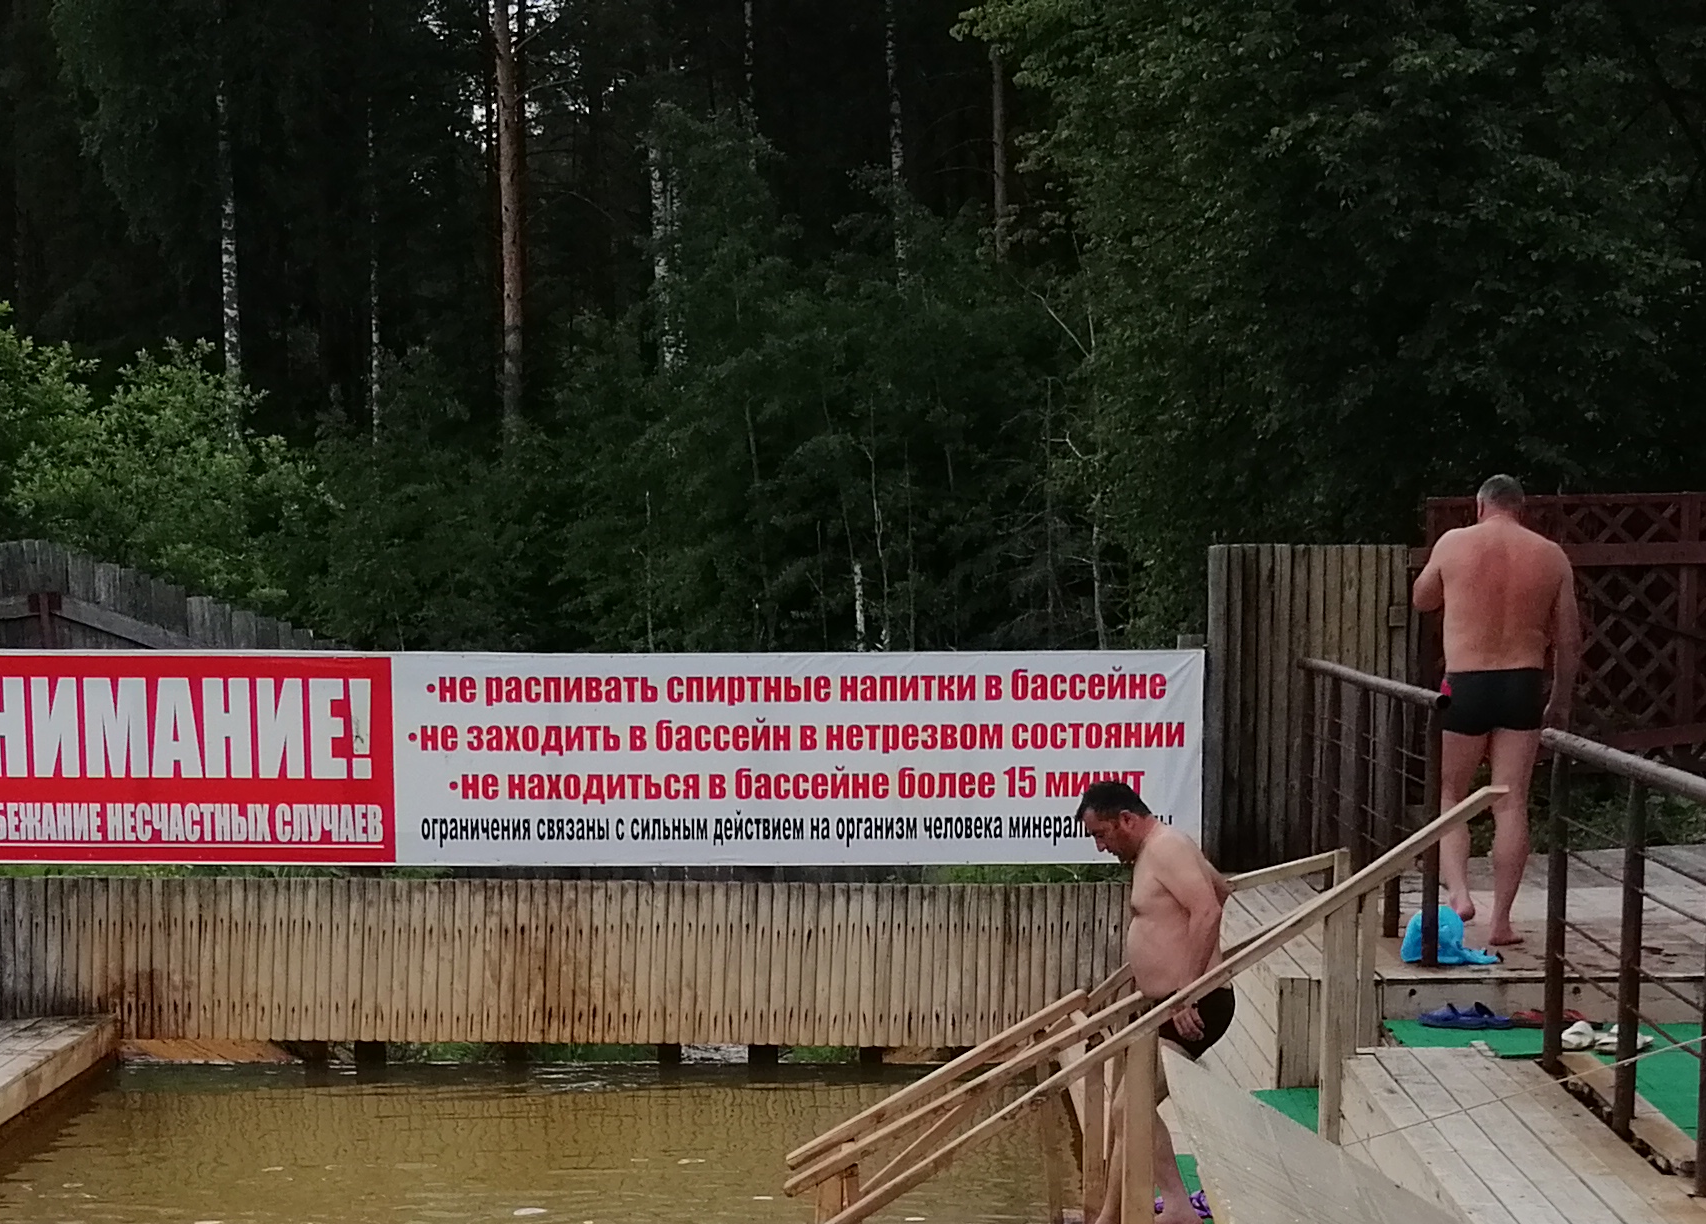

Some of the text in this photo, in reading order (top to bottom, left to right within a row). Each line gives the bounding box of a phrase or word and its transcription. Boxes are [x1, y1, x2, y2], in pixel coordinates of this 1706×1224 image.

[485, 676, 658, 707] распивать
[666, 675, 831, 706] спиртные
[840, 674, 976, 702] напитки
[985, 674, 1003, 701] в
[1011, 666, 1167, 702] бассейне
[466, 725, 621, 756] заходить
[629, 725, 647, 752] в
[655, 717, 791, 752] бассейн
[799, 724, 817, 751] в
[826, 723, 1003, 755] нетрезвом
[1011, 721, 1185, 750] состоянии
[508, 773, 701, 805] находиться
[708, 773, 726, 800] в
[734, 766, 890, 801] бассейне
[898, 767, 995, 799] более
[1003, 766, 1037, 798] 15
[106, 802, 272, 843] НЕСЧАСТНЫХ
[275, 803, 383, 843] СЛУЧАЕВ
[421, 817, 531, 848] ограничения
[536, 817, 610, 841] связаны
[615, 818, 625, 841] с
[630, 817, 708, 841] сильным
[713, 810, 804, 847] действием
[810, 816, 830, 841] на
[835, 815, 918, 848] организм
[923, 815, 1003, 840] человека
